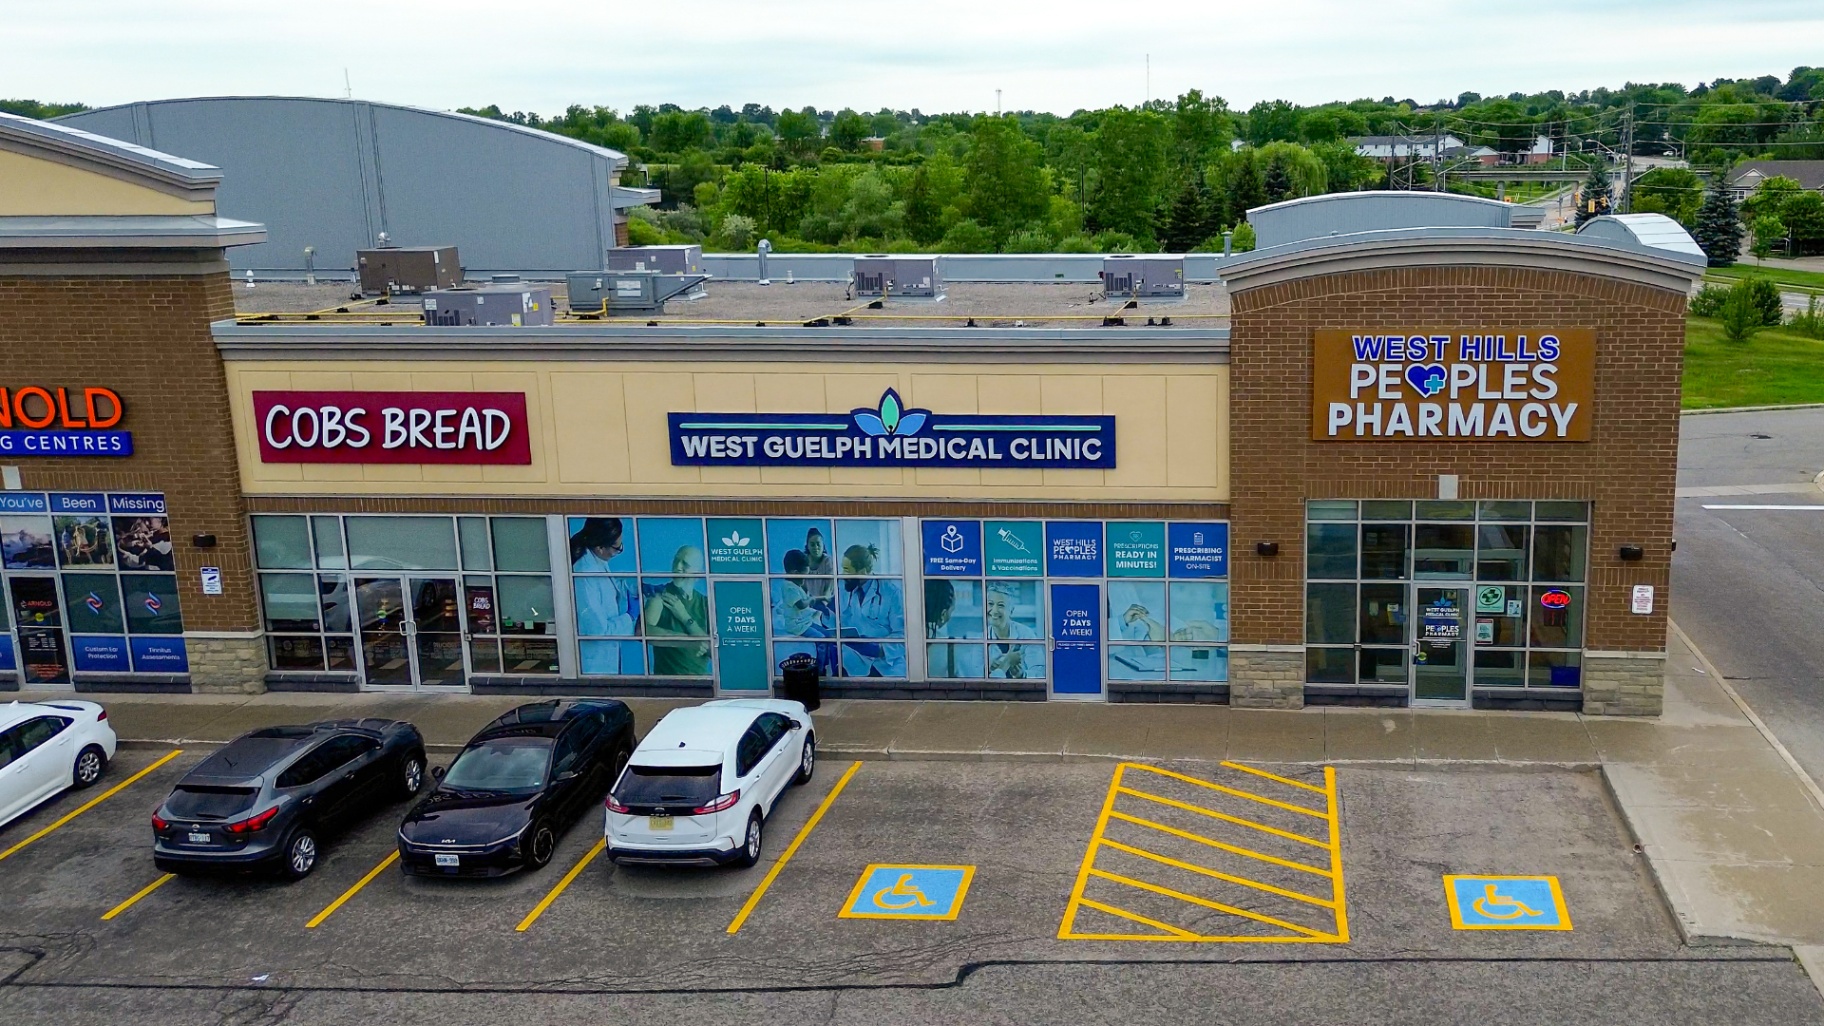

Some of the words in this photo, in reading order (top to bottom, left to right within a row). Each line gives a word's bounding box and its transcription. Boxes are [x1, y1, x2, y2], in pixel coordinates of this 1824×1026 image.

[1352, 335, 1450, 361] WEST
[1459, 335, 1560, 362] HILLS
[1328, 402, 1578, 437] PHARMACY
[265, 405, 371, 449] COBS
[381, 407, 511, 451] BREAD
[24, 435, 122, 451] CENTRES
[681, 436, 758, 458] WEST
[763, 436, 872, 459] GUELPH
[879, 437, 1002, 460] MEDICAL
[1009, 438, 1102, 460] CLINIC
[0, 497, 44, 508] You've
[62, 497, 97, 508] Been
[113, 498, 165, 512] Missing
[1076, 539, 1097, 547] HILLS
[1115, 551, 1144, 559] READY
[1147, 551, 1157, 559] IN
[1115, 561, 1157, 569] MINUTES!
[1543, 593, 1569, 605] OPEN
[730, 606, 752, 614] OPEN
[1066, 610, 1088, 618] OPEN
[1063, 619, 1068, 627] 7
[1070, 619, 1091, 627] DAYS
[1061, 628, 1068, 636] A
